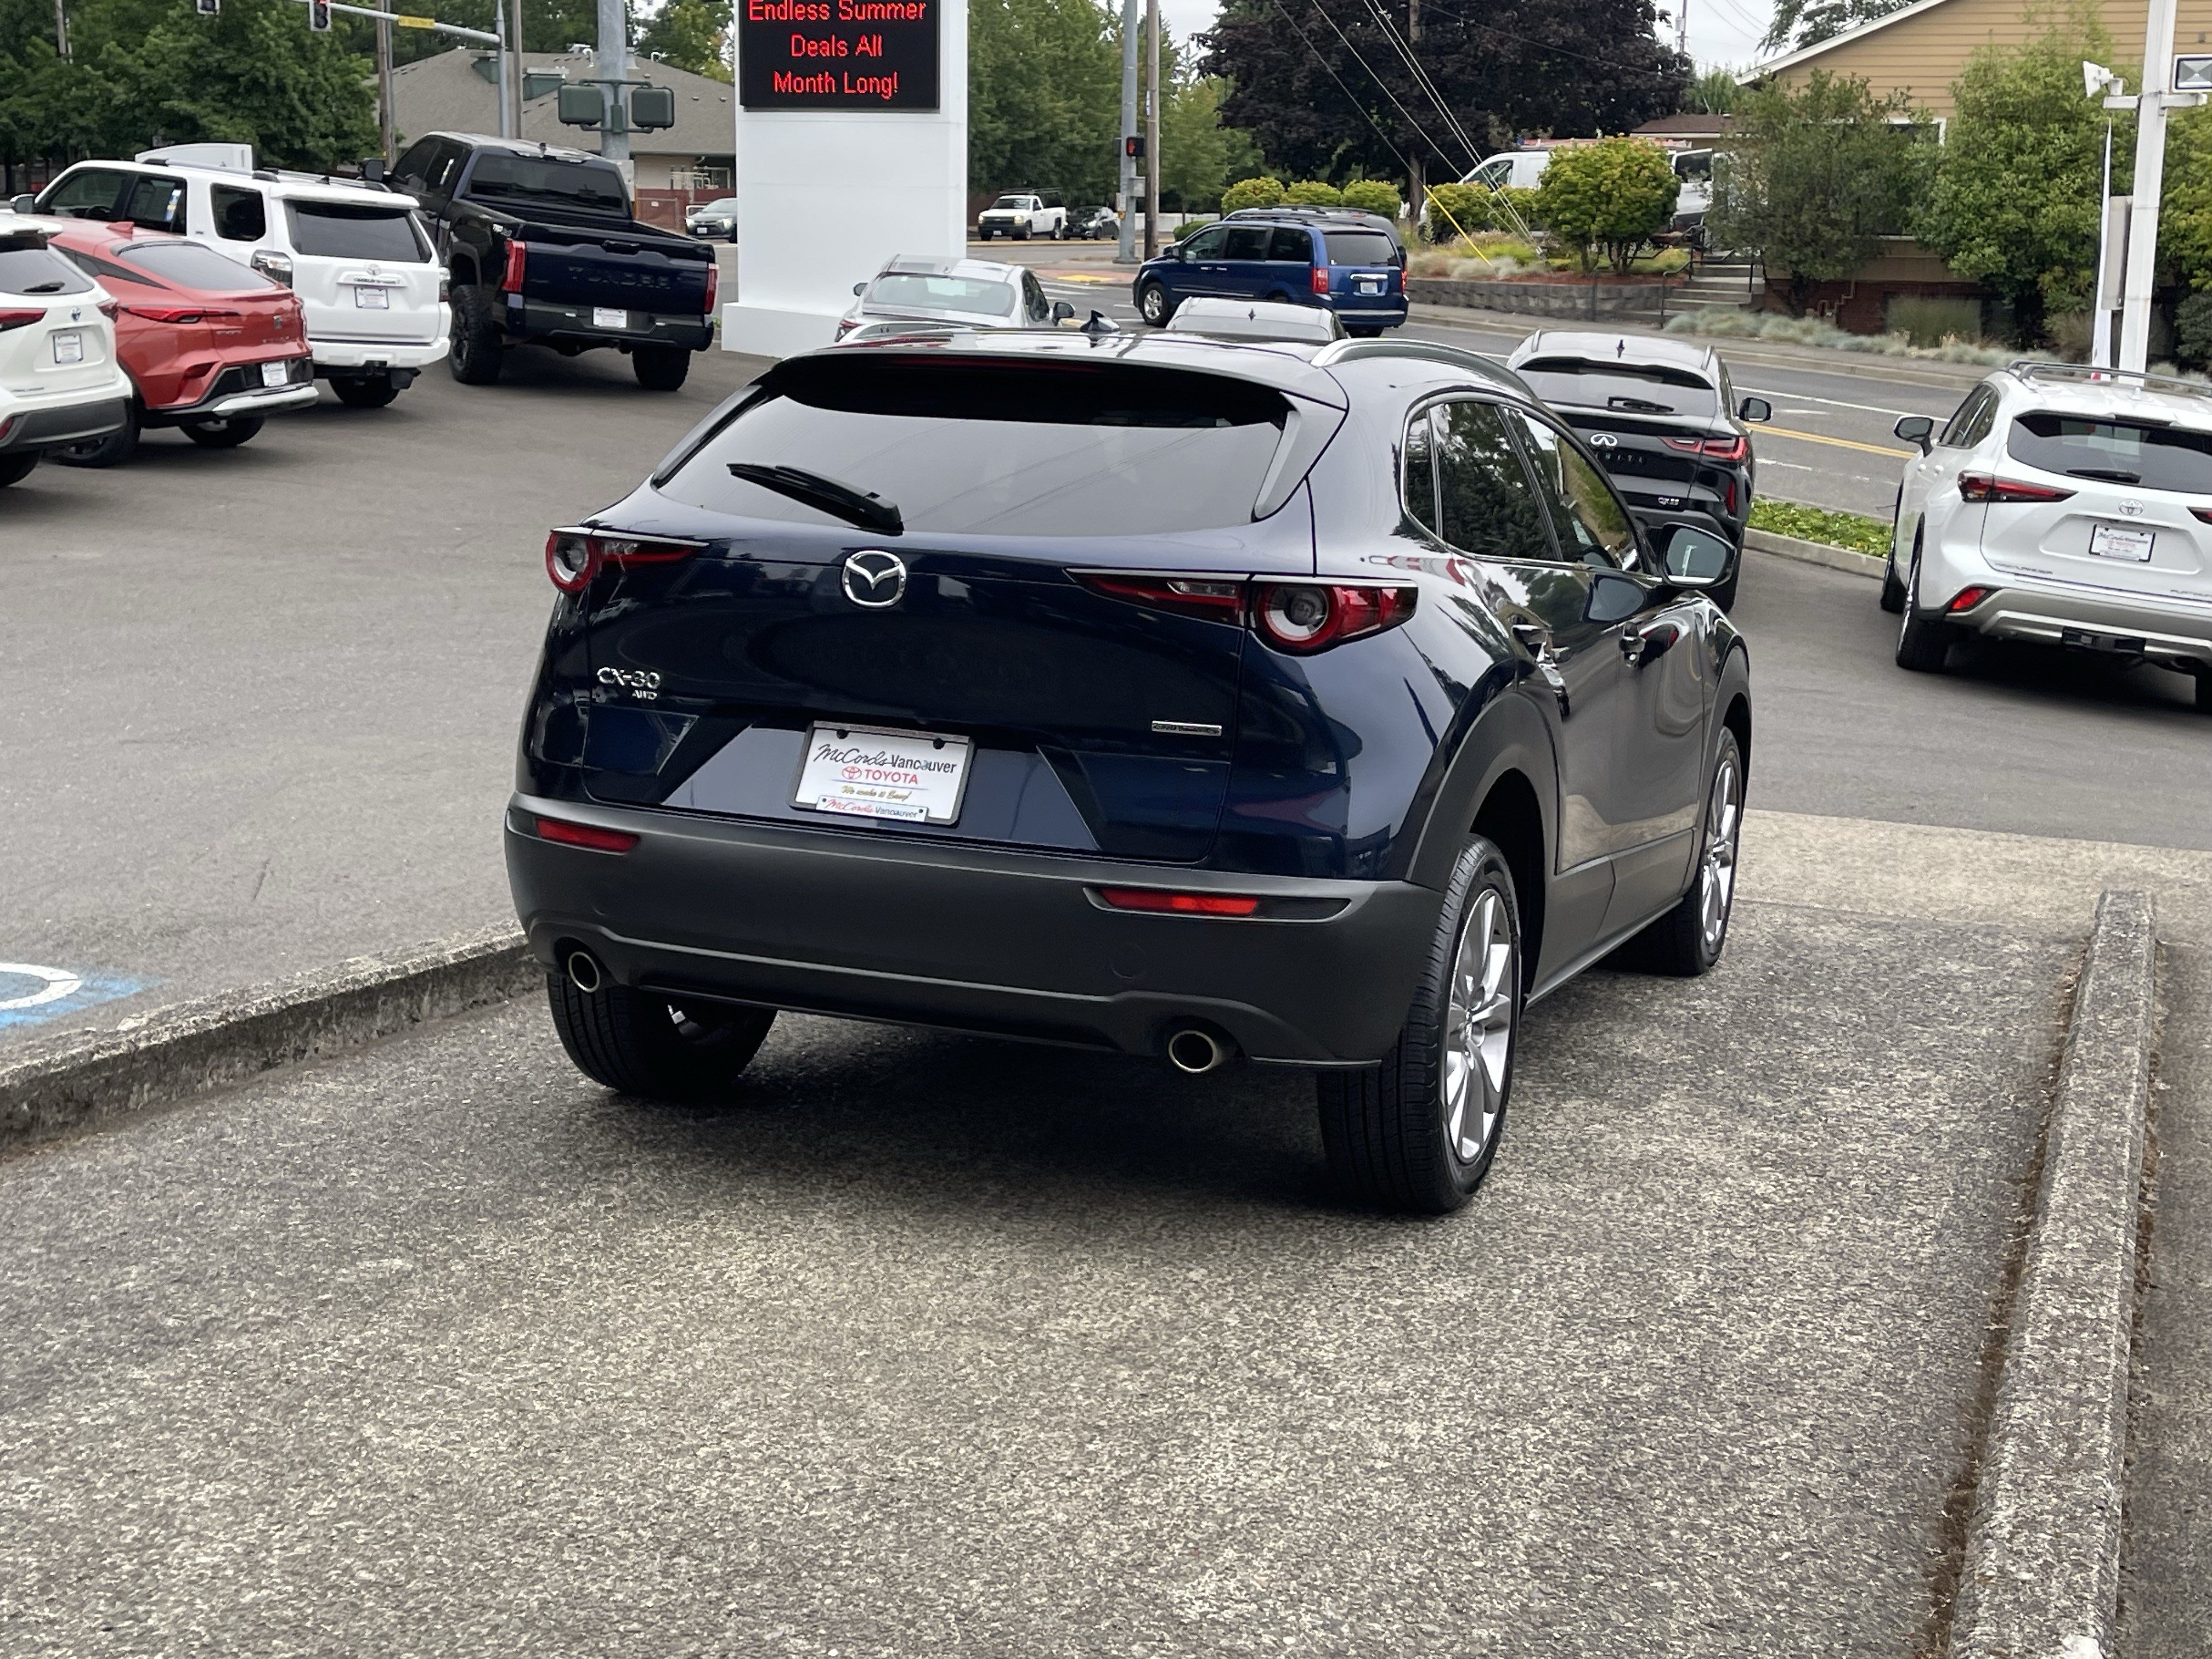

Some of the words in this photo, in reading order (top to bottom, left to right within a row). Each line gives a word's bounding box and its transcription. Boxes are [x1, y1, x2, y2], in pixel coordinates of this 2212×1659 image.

[748, 0, 831, 21] Endless
[838, 0, 927, 21] Summer
[791, 33, 849, 58] Deals
[855, 33, 883, 57] All
[773, 70, 837, 94] Month
[843, 70, 899, 101] Long!
[596, 667, 661, 690] CX-30
[813, 743, 891, 766] McCords
[865, 769, 918, 785] TOYOTA
